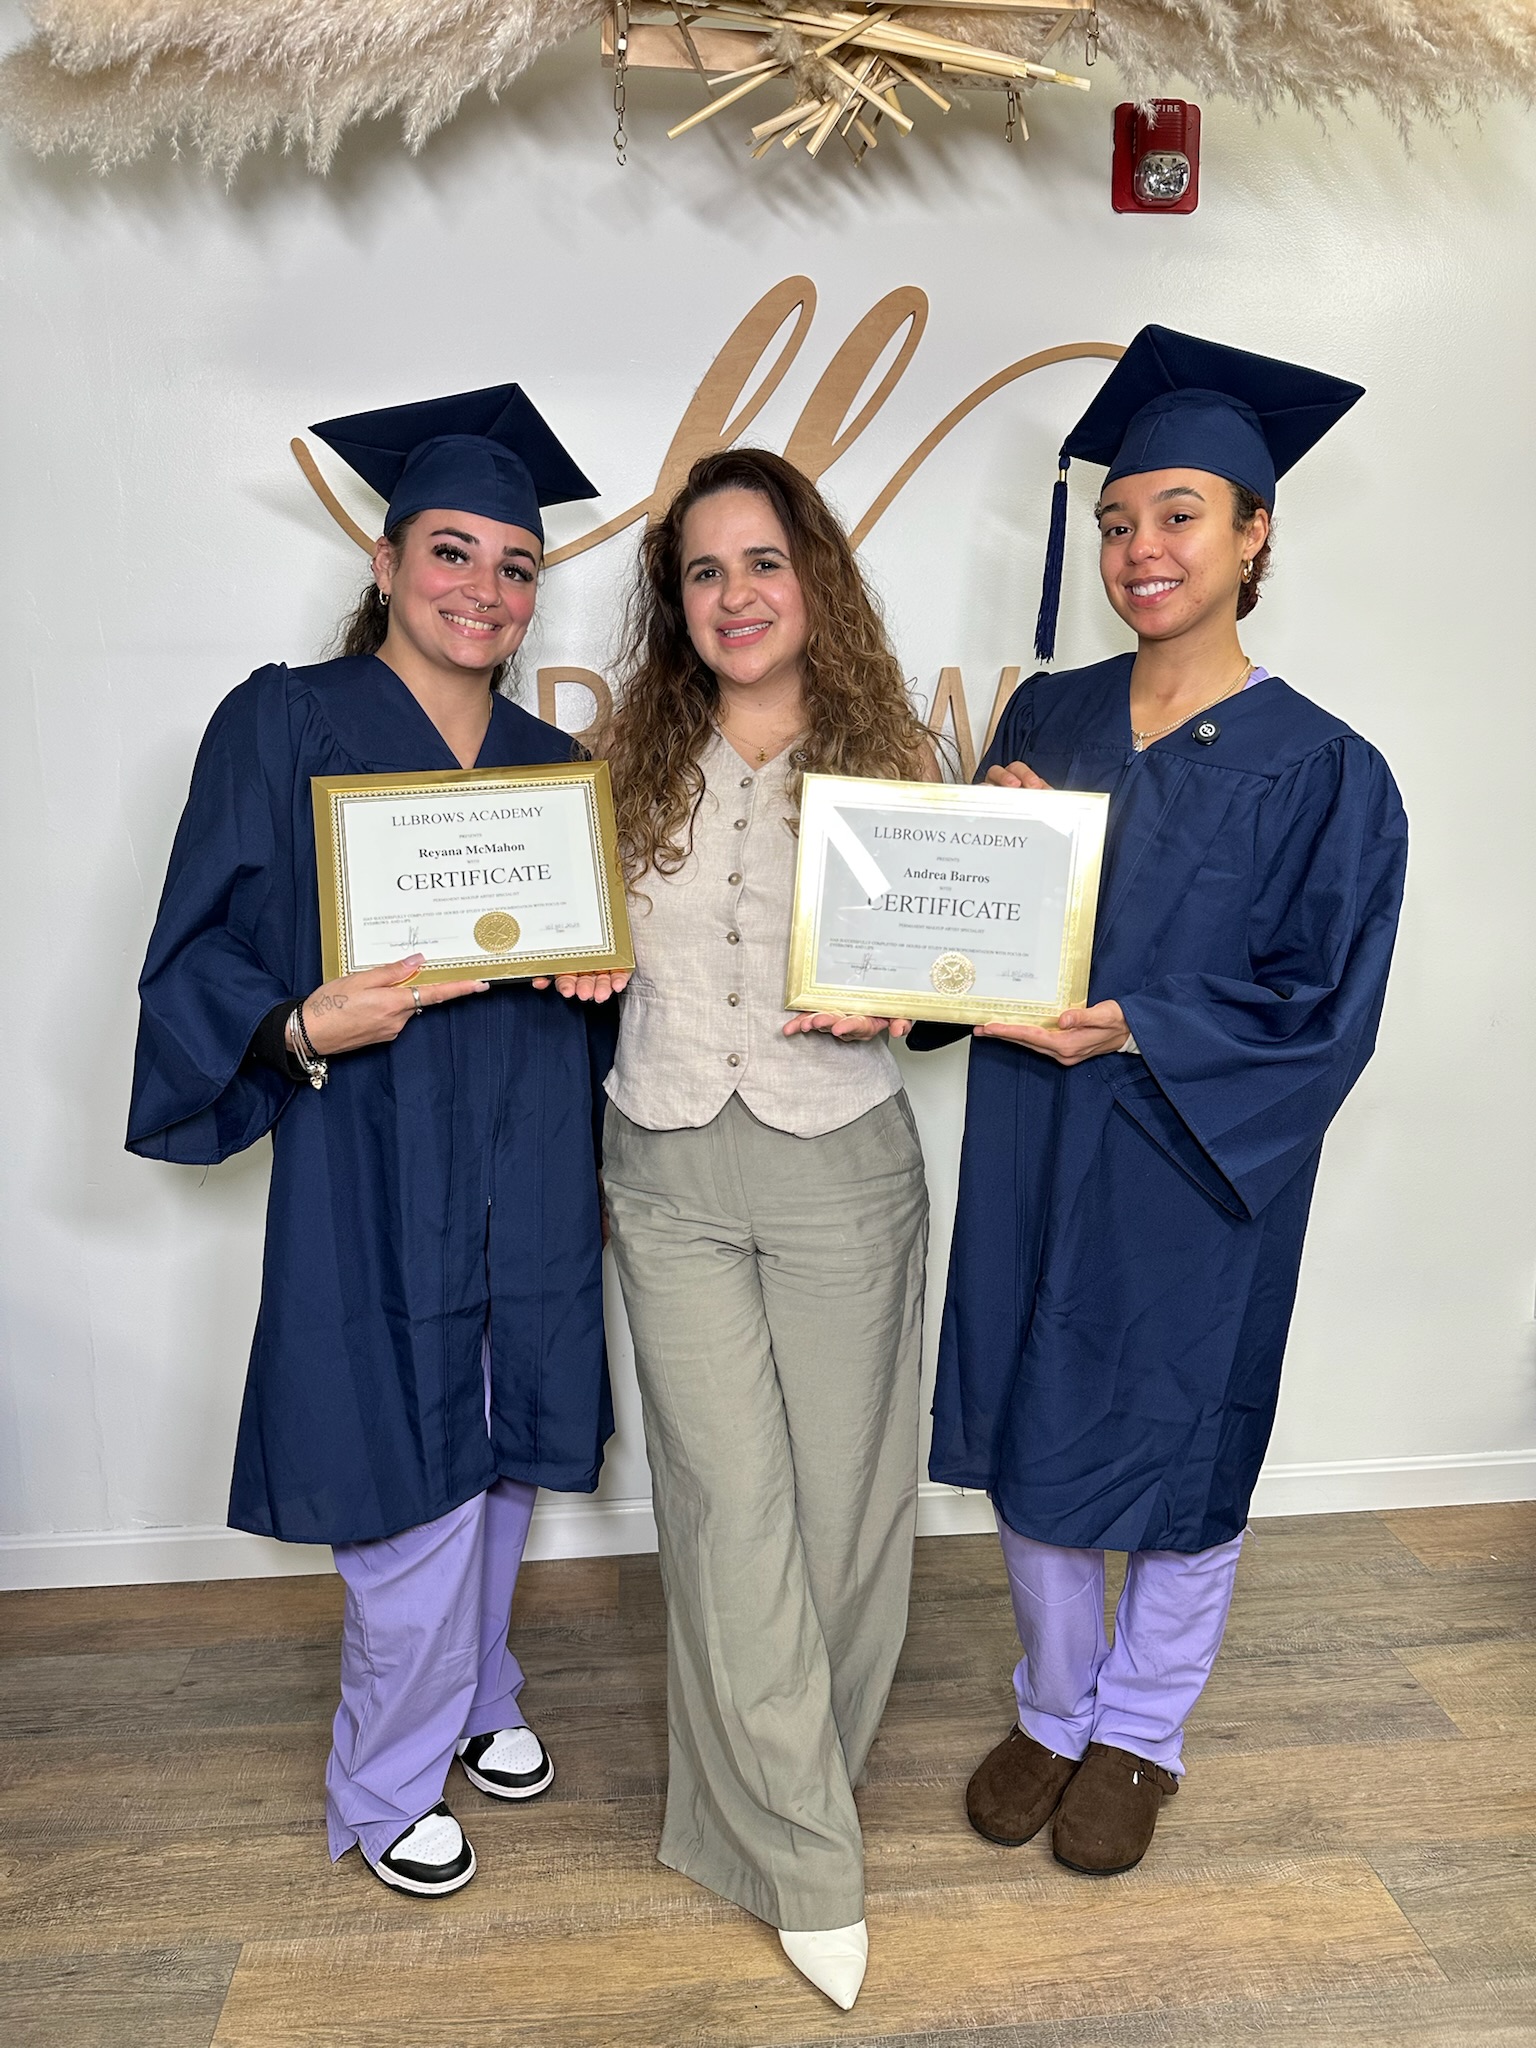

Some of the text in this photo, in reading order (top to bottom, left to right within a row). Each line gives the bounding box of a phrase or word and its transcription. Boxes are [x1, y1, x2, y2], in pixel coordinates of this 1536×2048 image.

[1155, 104, 1180, 113] FIRE
[392, 806, 544, 827] LLBROWS ACADEMY
[873, 826, 1028, 849] LLBROWS ACADEMY
[418, 842, 525, 859] Reyana McMahon
[397, 864, 552, 891] CERTIFICATE
[903, 867, 991, 884] Andrea Barros
